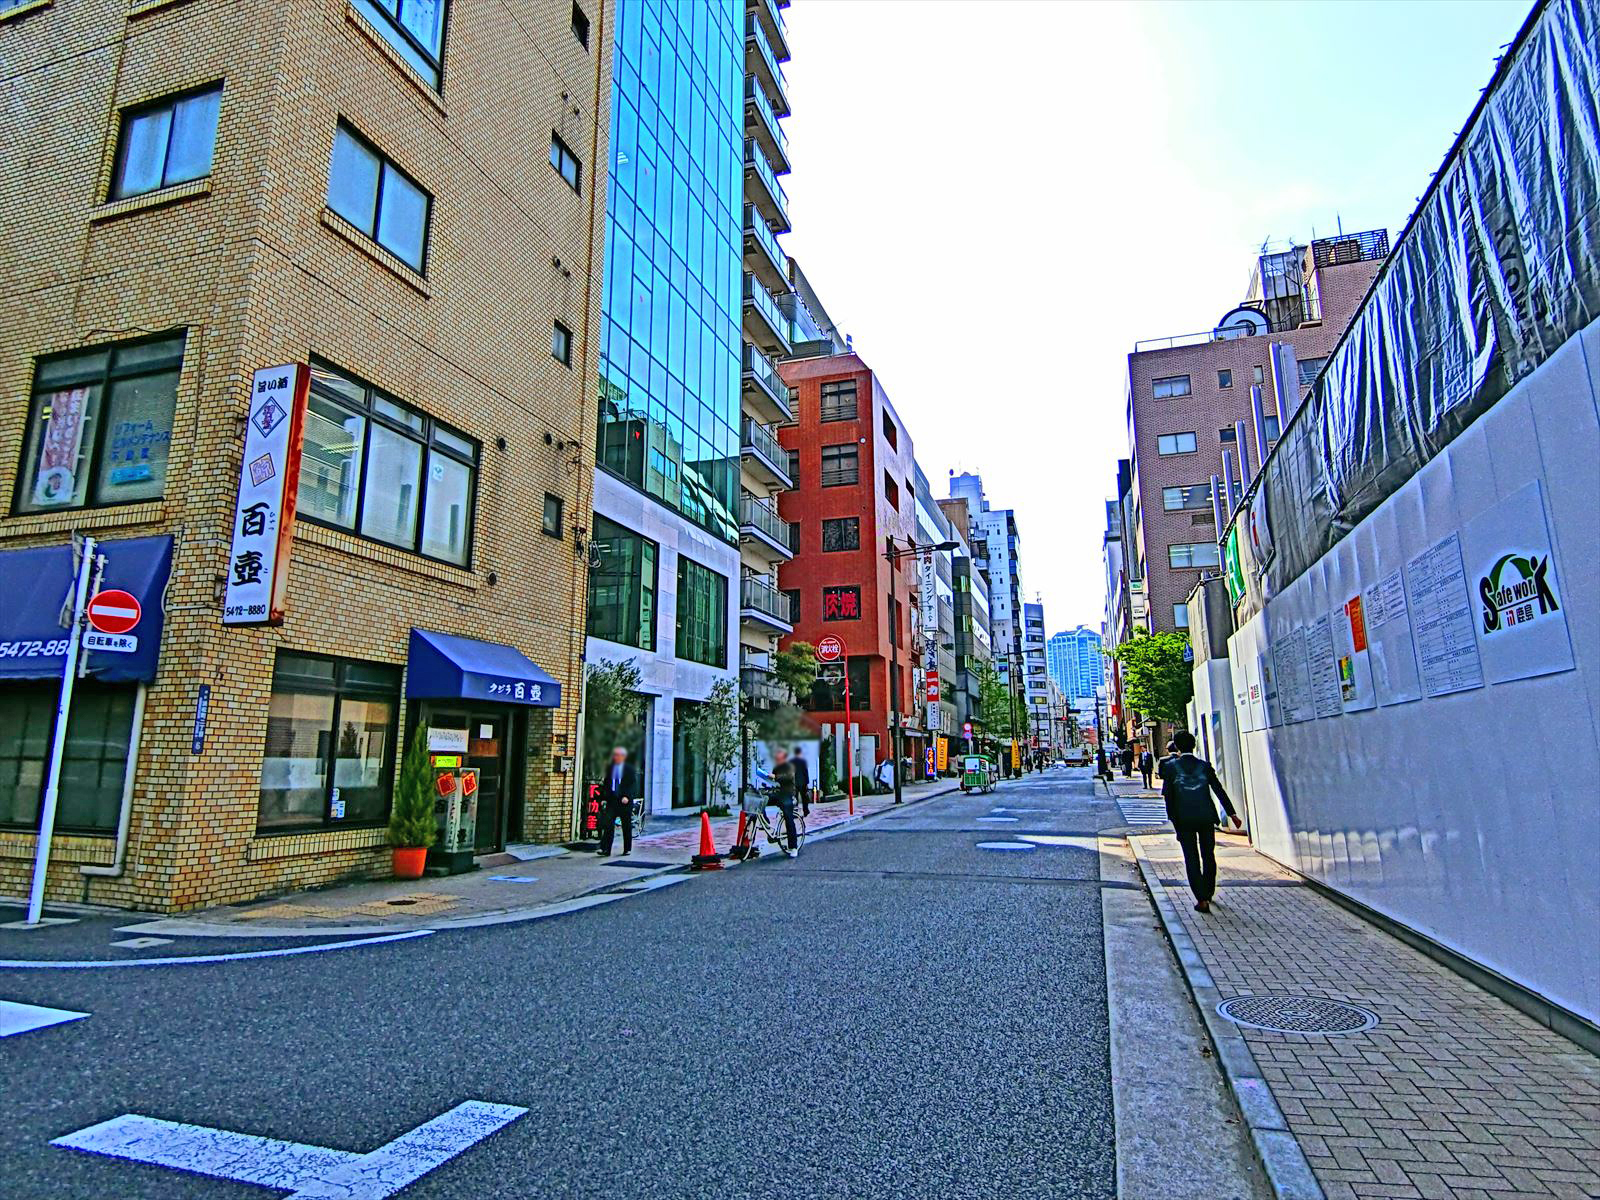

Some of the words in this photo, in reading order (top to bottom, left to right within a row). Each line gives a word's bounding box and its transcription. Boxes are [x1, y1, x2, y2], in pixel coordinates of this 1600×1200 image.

[225, 604, 267, 617] 5472-8880
[0, 639, 71, 658] 5472-88
[87, 636, 133, 649] 自転車を除く
